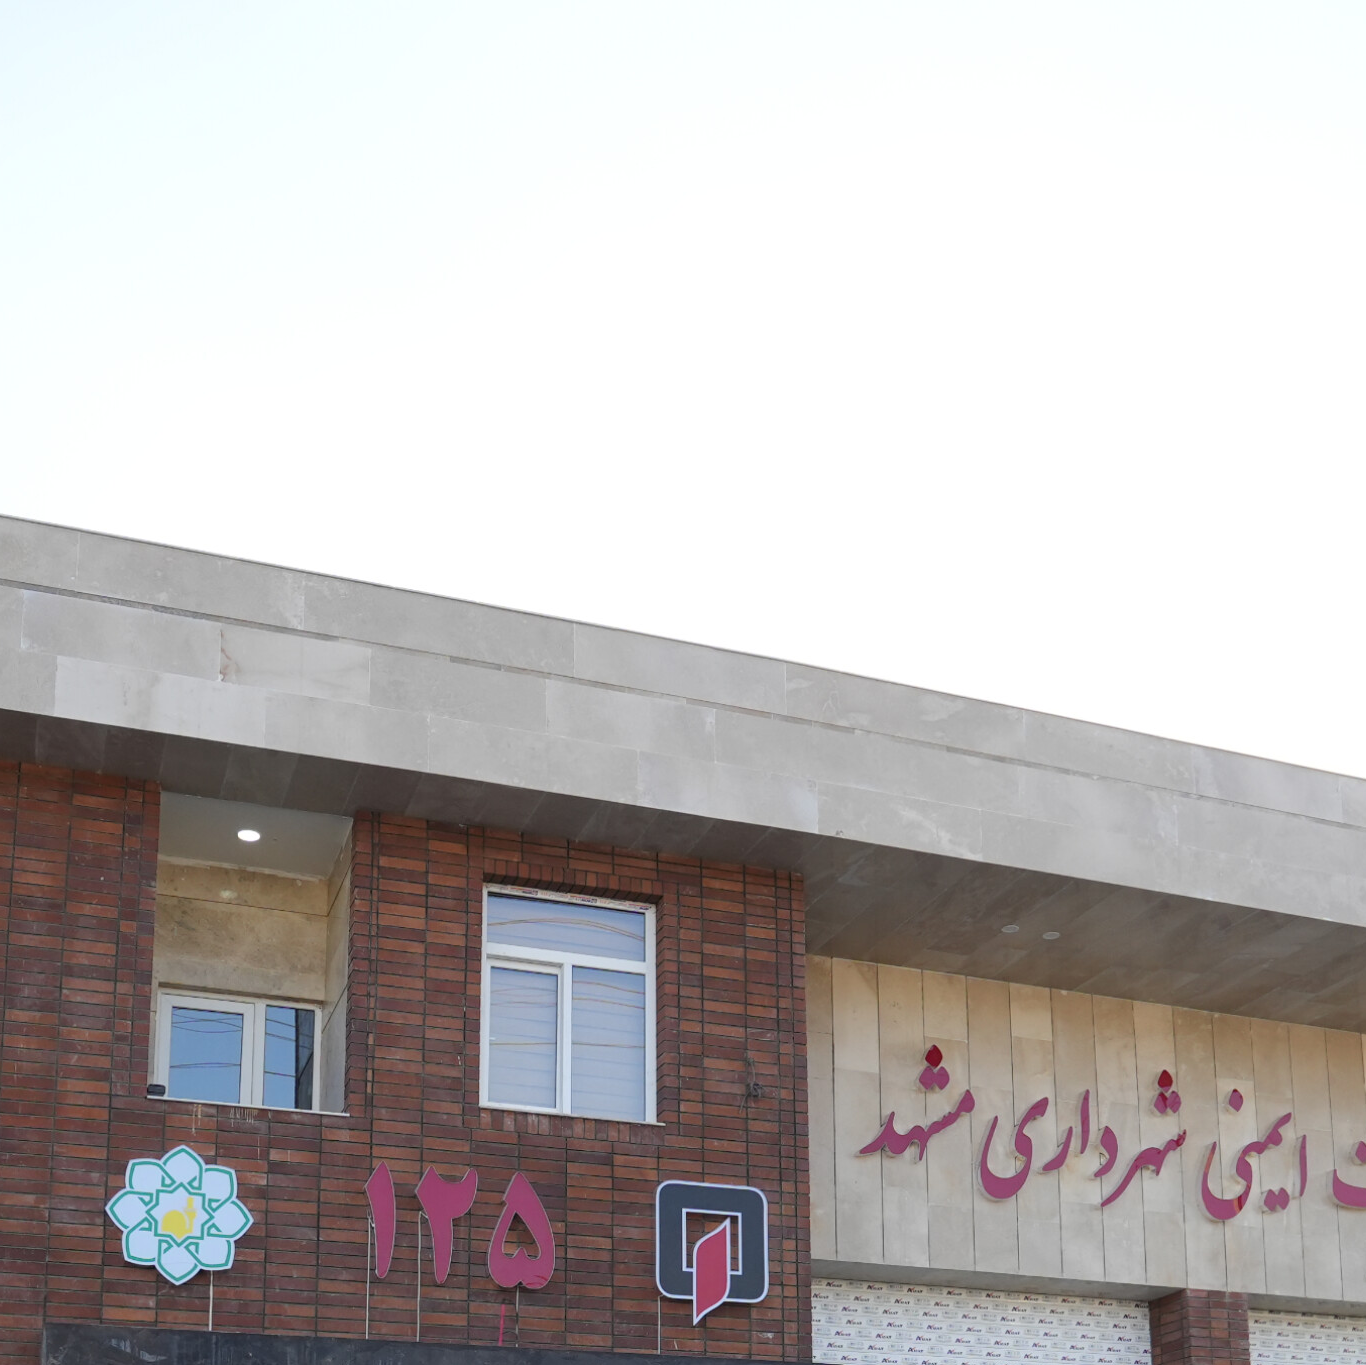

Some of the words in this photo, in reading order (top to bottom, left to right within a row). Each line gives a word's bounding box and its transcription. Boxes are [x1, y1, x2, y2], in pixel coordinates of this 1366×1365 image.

[857, 1043, 976, 1163] مشهد
[978, 1069, 1187, 1208] شهرداری
[1200, 1088, 1307, 1221] ایمنی
[363, 1160, 556, 1290] ۱۲۵
